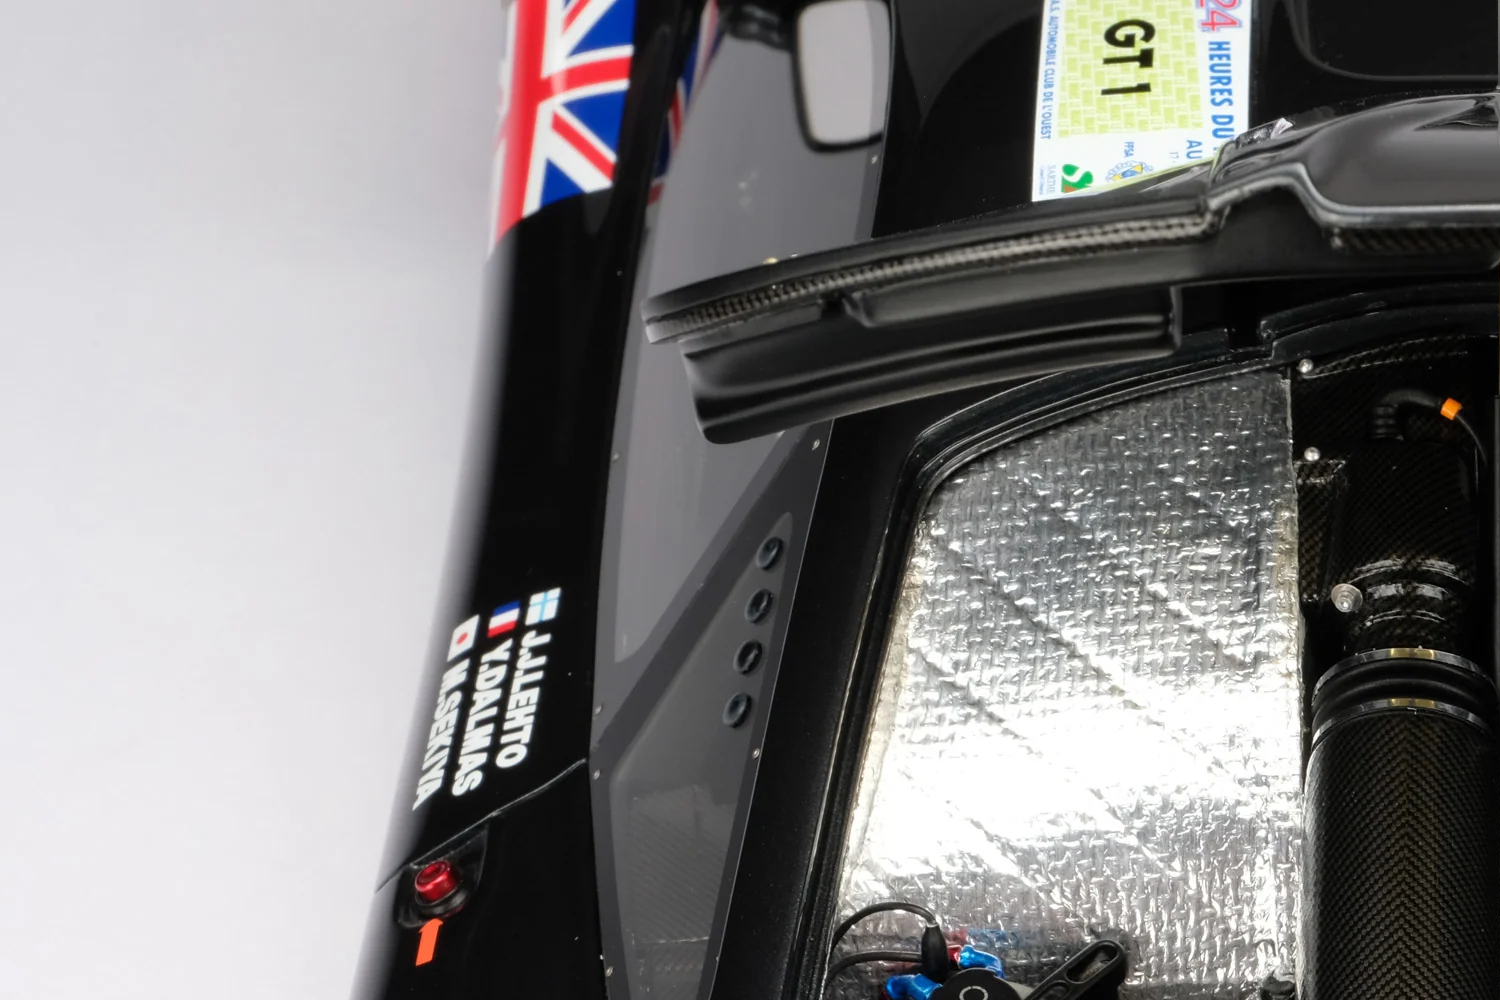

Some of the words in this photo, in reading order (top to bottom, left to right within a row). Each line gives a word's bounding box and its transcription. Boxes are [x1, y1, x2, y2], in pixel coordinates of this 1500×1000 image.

[1044, 15, 1059, 66] AUTOMOBILE
[1043, 68, 1055, 90] CLUB
[1207, 41, 1233, 107] HEURES
[1042, 91, 1054, 103] DE
[1040, 105, 1053, 140] L'OUEST
[1211, 114, 1235, 140] DU
[1185, 140, 1203, 160] AU
[452, 637, 513, 797] Y.DALMAS
[496, 630, 552, 769] J.J.LEHTO
[412, 657, 471, 812] M.SEKIYA
